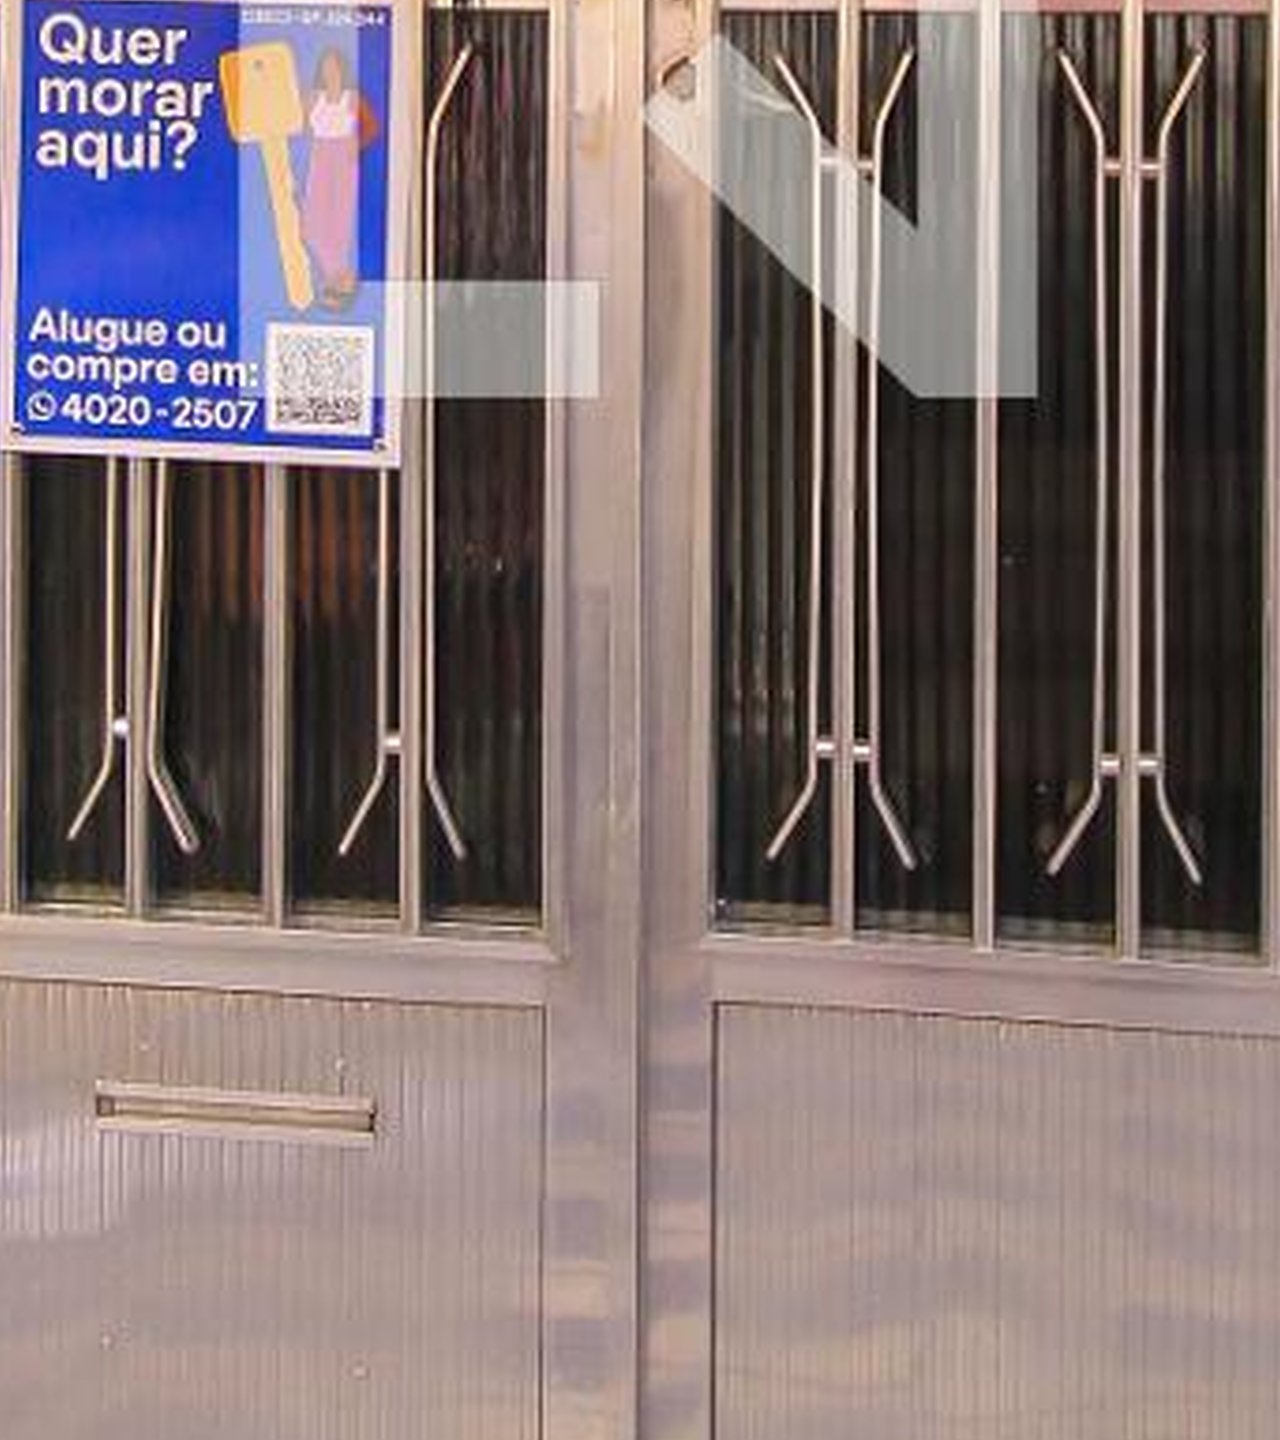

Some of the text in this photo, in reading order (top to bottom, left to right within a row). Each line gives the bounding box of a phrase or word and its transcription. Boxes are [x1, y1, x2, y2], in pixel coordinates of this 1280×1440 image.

[39, 13, 187, 67] Quer
[37, 78, 213, 119] morar
[35, 121, 199, 180] aqui?
[28, 307, 226, 353] Alugue ou
[26, 353, 259, 392] compre em:
[61, 392, 258, 432] 4020-2507
